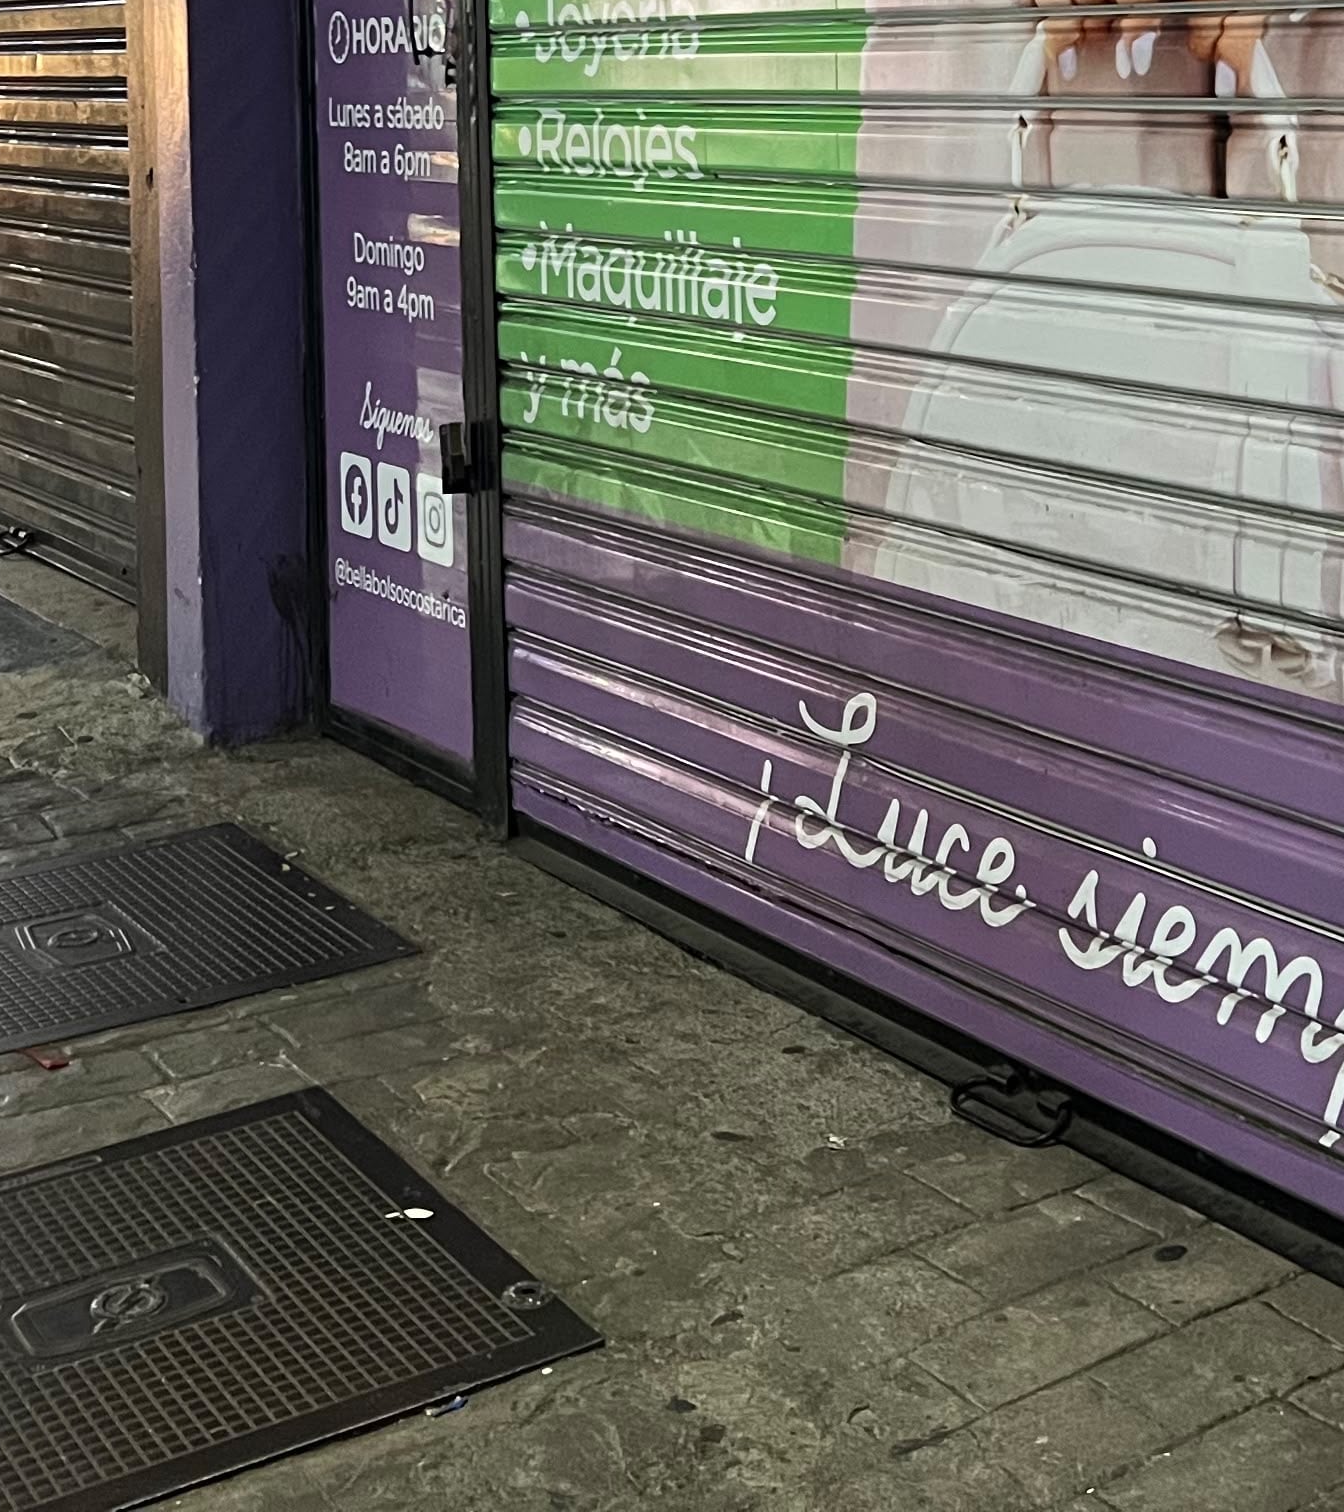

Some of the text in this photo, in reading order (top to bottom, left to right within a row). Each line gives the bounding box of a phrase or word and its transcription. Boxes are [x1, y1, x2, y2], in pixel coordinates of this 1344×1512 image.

[352, 13, 446, 54] HORARIO
[329, 96, 445, 130] Lunes a sábado
[344, 141, 431, 182] 8am a 6pm
[537, 108, 704, 192] Relojes
[354, 232, 425, 275] Domingo
[346, 276, 435, 323] 9am a 4pm
[540, 220, 780, 342] Maquillaje
[520, 346, 656, 433] y más
[335, 557, 467, 628] @bellabolsoscostarica
